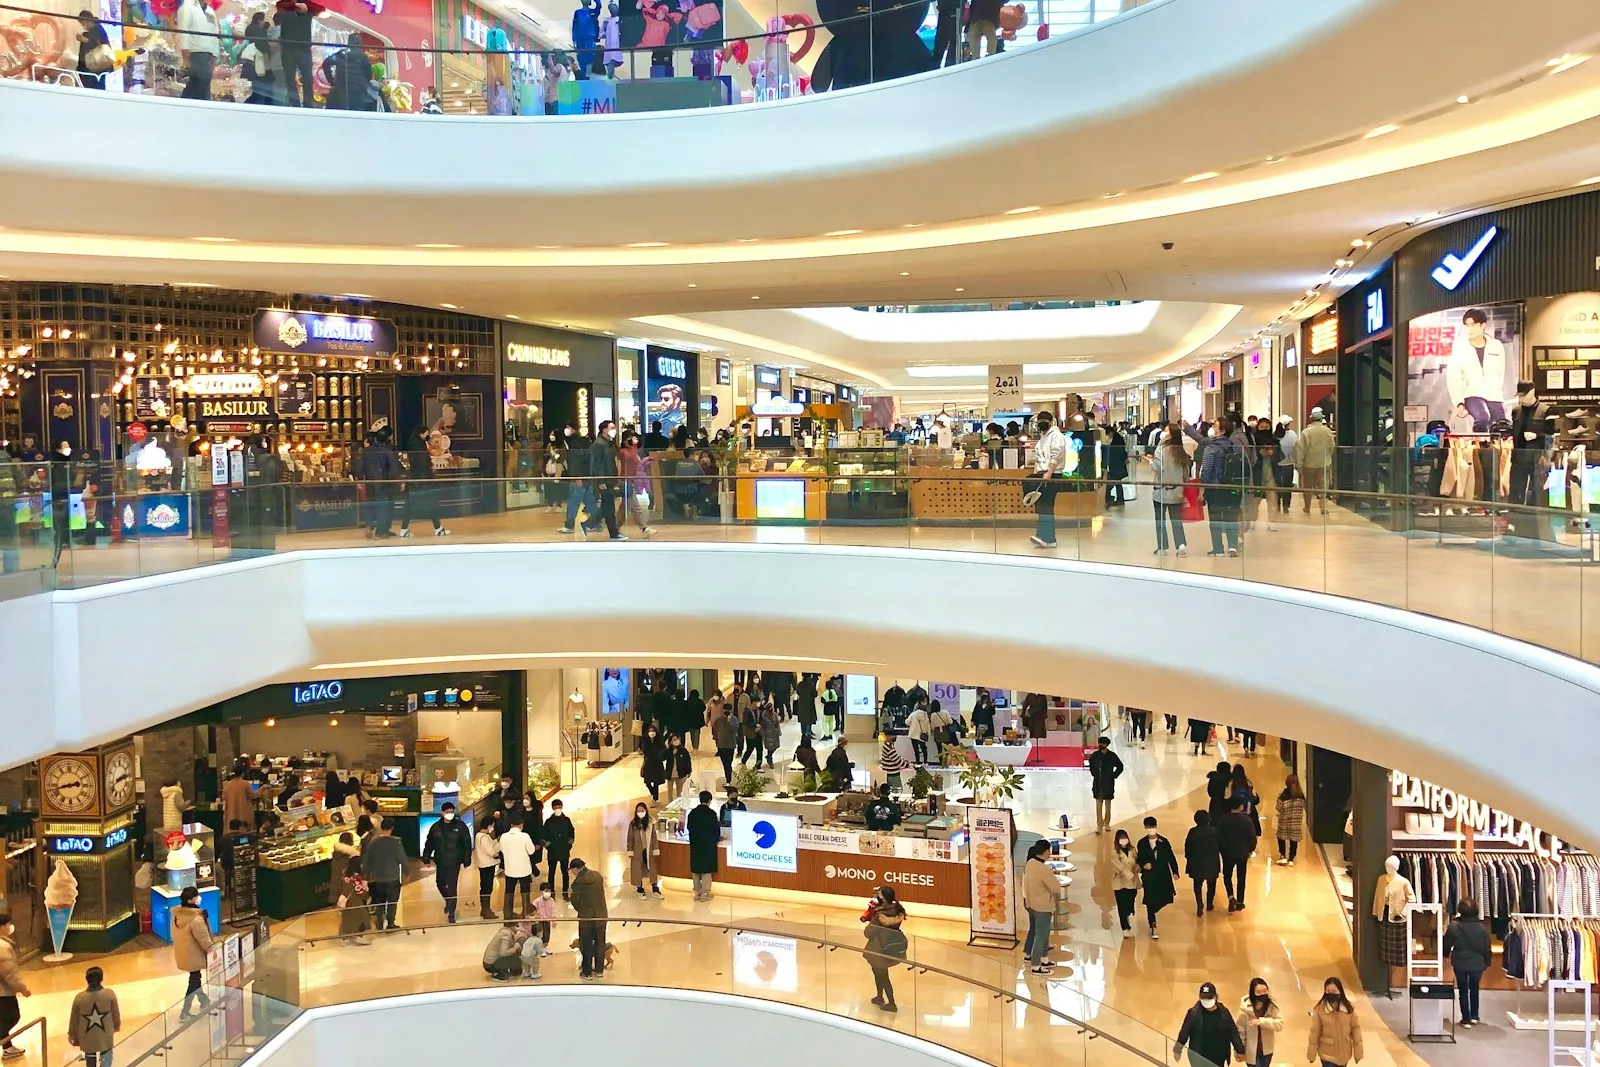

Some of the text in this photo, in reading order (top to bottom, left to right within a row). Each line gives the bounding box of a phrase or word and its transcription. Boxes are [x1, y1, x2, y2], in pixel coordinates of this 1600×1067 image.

[313, 319, 374, 342] BASILUR
[1409, 342, 1453, 357] 리지널
[658, 356, 687, 379] GUESS
[202, 400, 270, 416] BASILUR
[295, 681, 342, 703] LeTAO
[1391, 769, 1563, 864] PLATFORM PLACE
[56, 838, 93, 851] LeTAO
[830, 835, 847, 843] CHEESE
[736, 851, 793, 865] MONO CHEESE
[837, 866, 935, 887] MONO CHEESE
